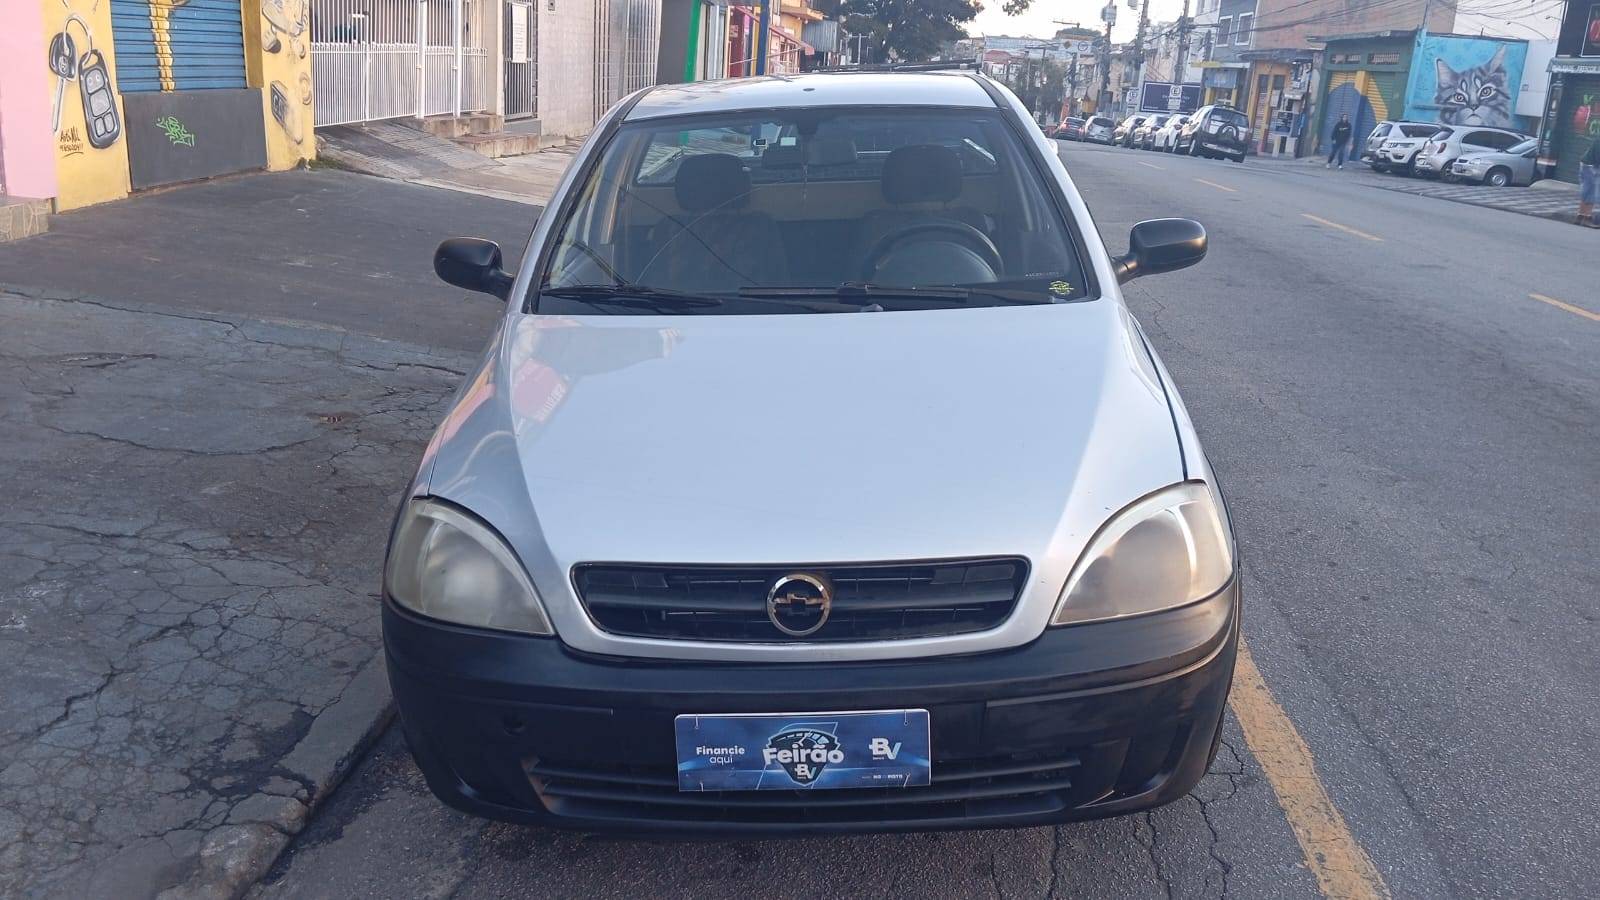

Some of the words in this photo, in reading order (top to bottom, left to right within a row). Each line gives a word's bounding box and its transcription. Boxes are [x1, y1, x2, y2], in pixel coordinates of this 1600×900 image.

[696, 745, 745, 755] Financie
[762, 743, 844, 765] Feirão
[869, 738, 902, 760] BV
[709, 755, 733, 766] aqui
[794, 763, 817, 779] BV
